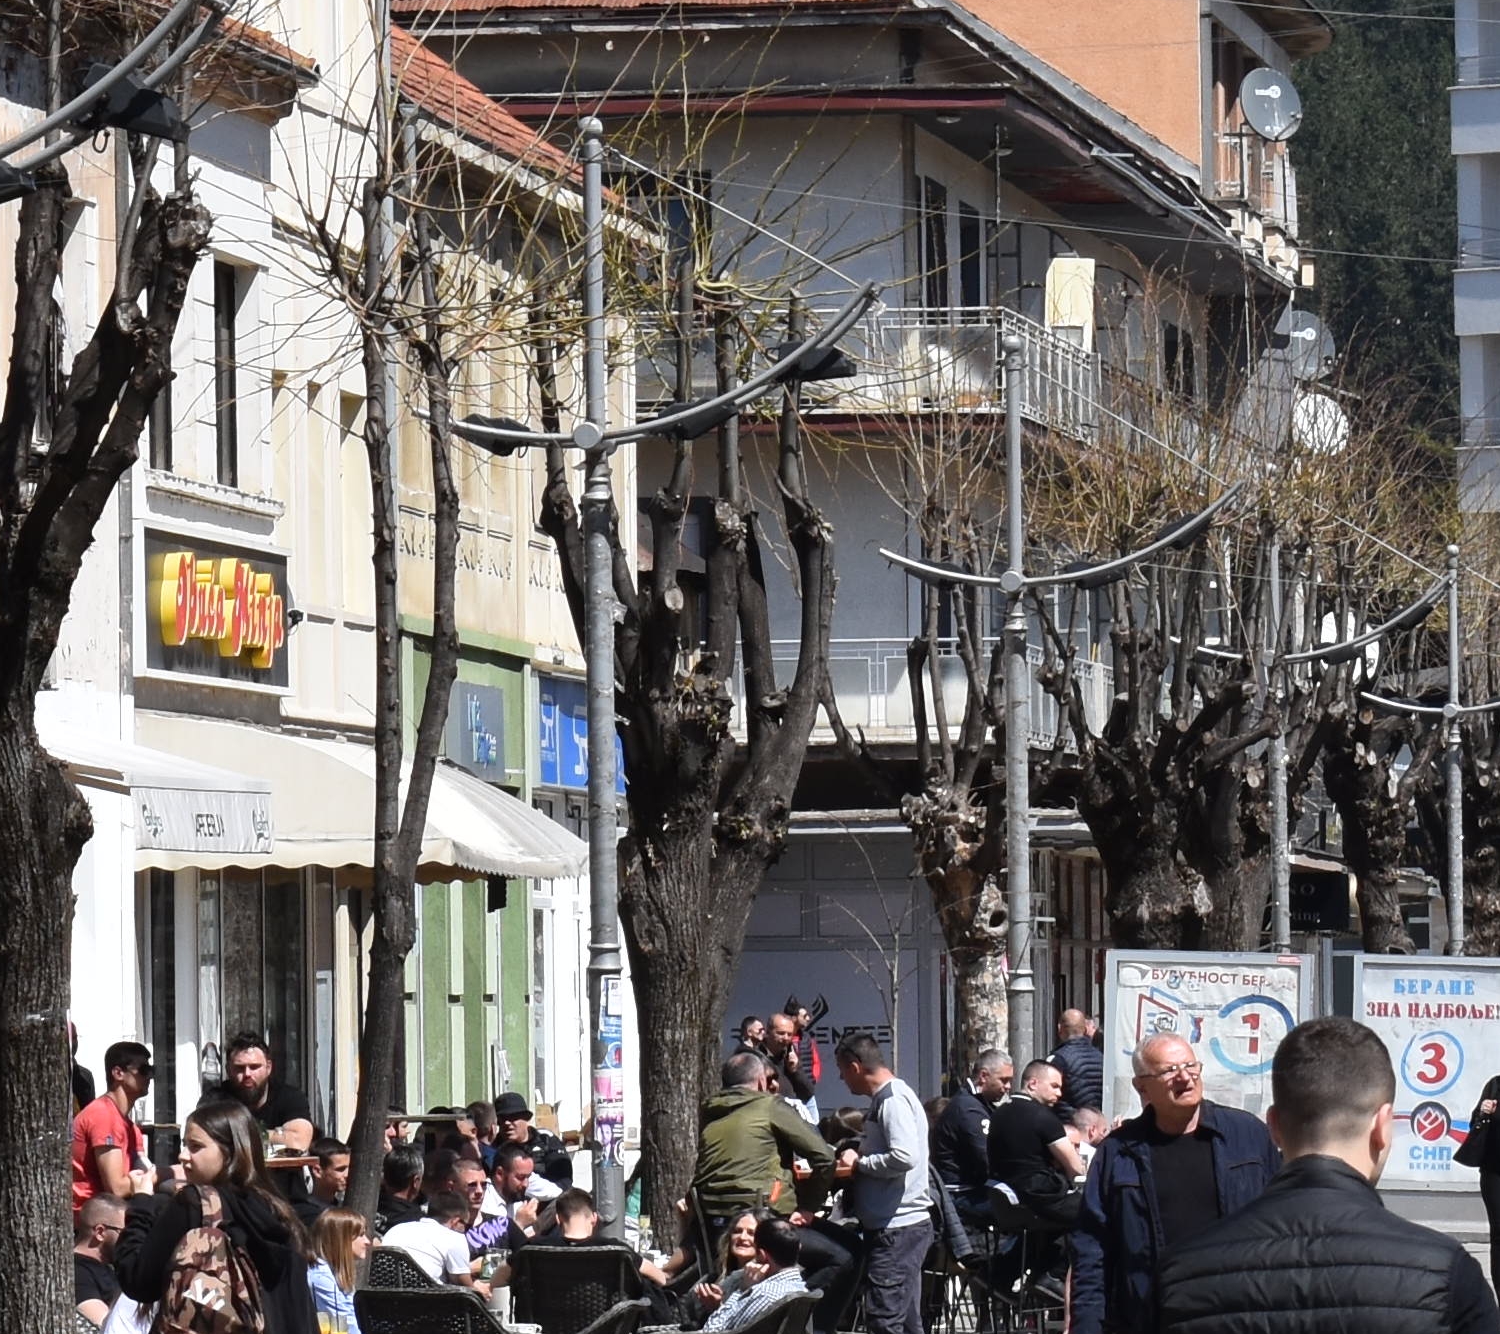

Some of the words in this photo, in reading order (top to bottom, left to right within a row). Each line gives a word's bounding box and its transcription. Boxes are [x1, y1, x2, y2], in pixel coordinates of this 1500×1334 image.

[1393, 978, 1476, 996] БЕРАНЕ
[1366, 1002, 1402, 1018] ЗНА
[1407, 1002, 1500, 1020] НАЈБОЉЕ!
[1241, 1013, 1261, 1055] 1
[1416, 1042, 1448, 1084] 3
[1408, 1145, 1452, 1162] СНП
